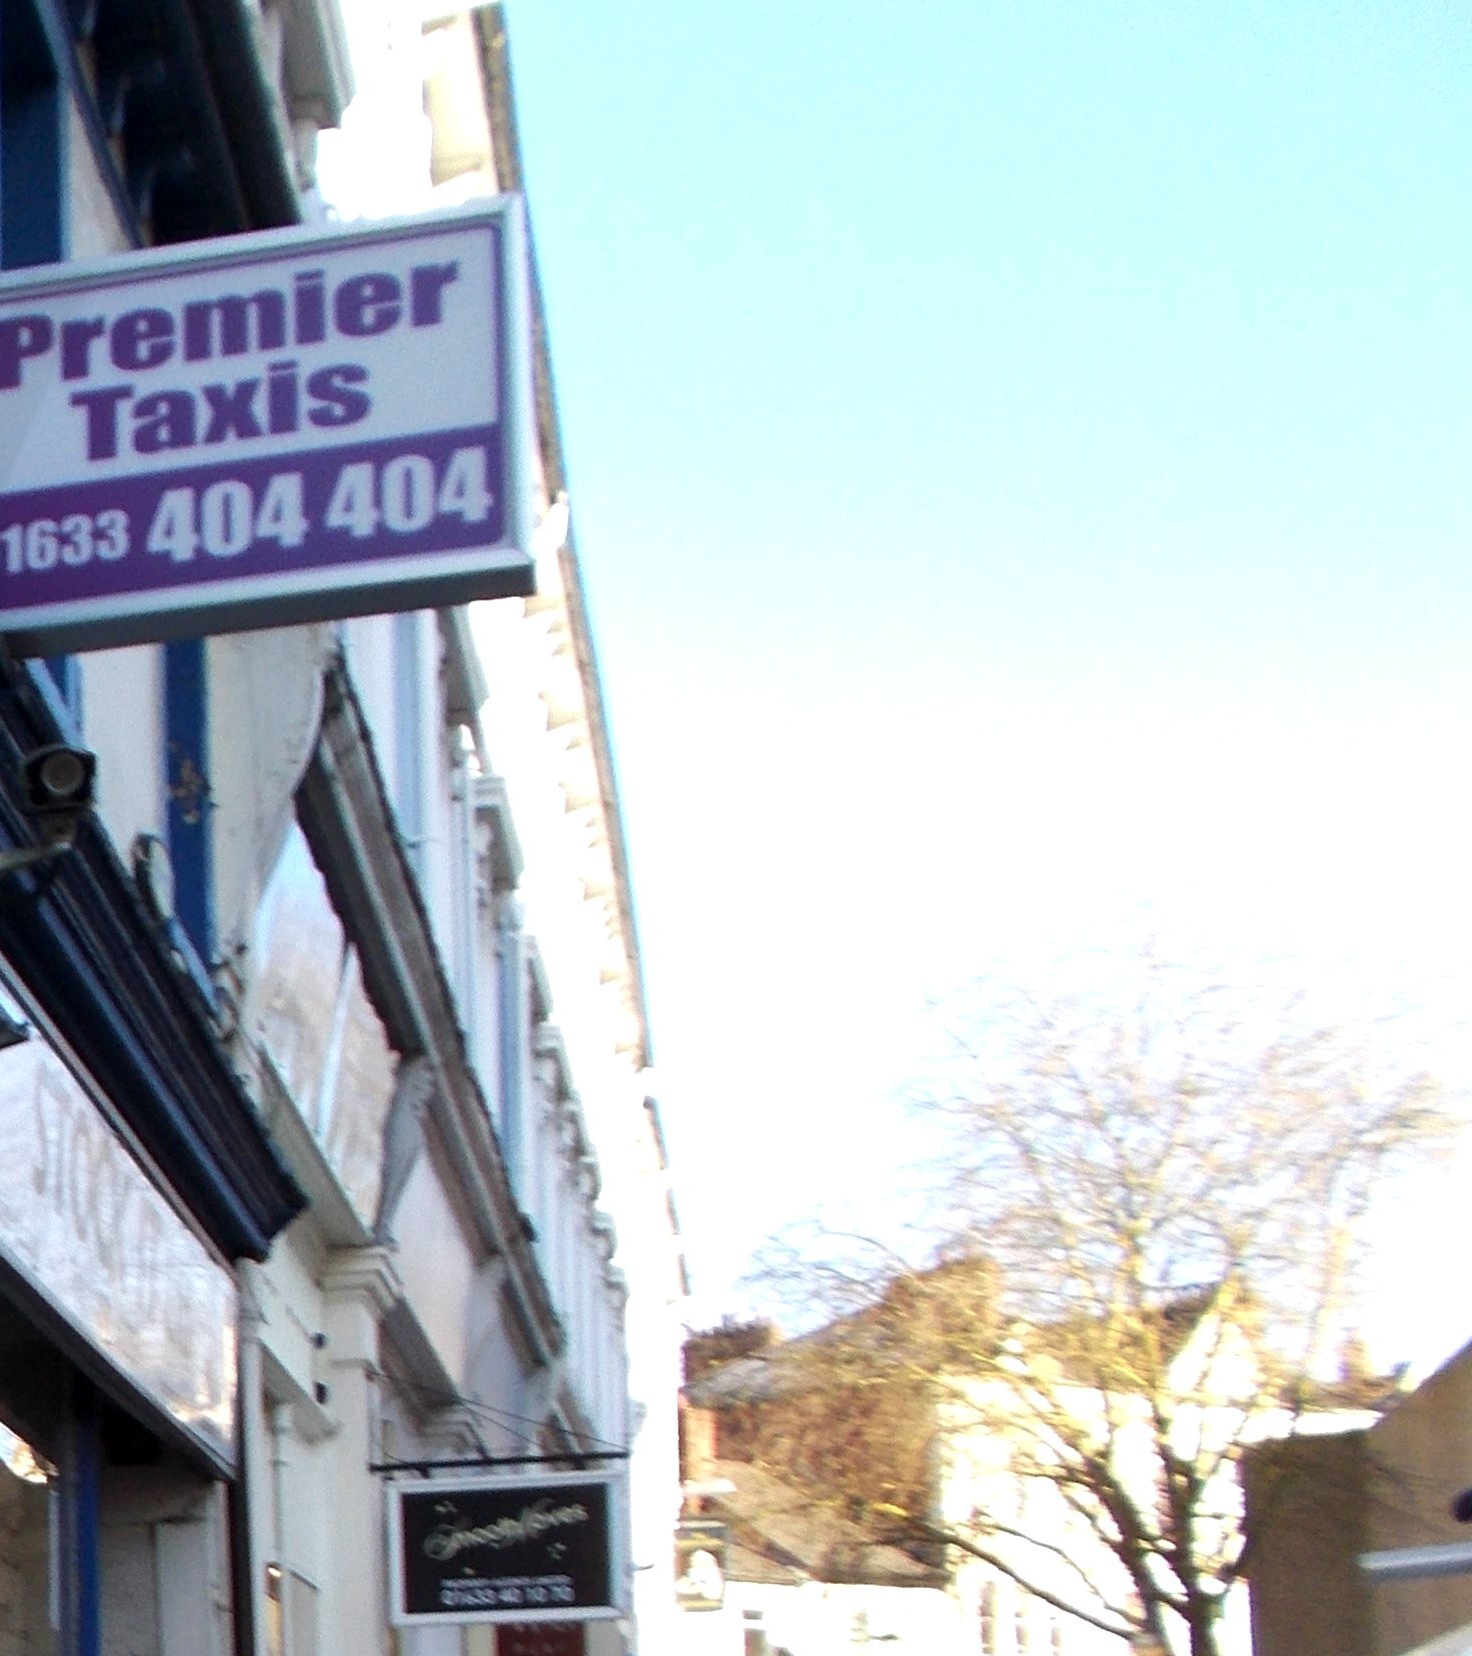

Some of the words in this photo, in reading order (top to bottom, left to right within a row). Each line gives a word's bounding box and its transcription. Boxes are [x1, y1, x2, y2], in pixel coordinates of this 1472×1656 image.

[69, 360, 372, 463] Taxis
[146, 472, 308, 564] 404
[326, 446, 494, 536] 404
